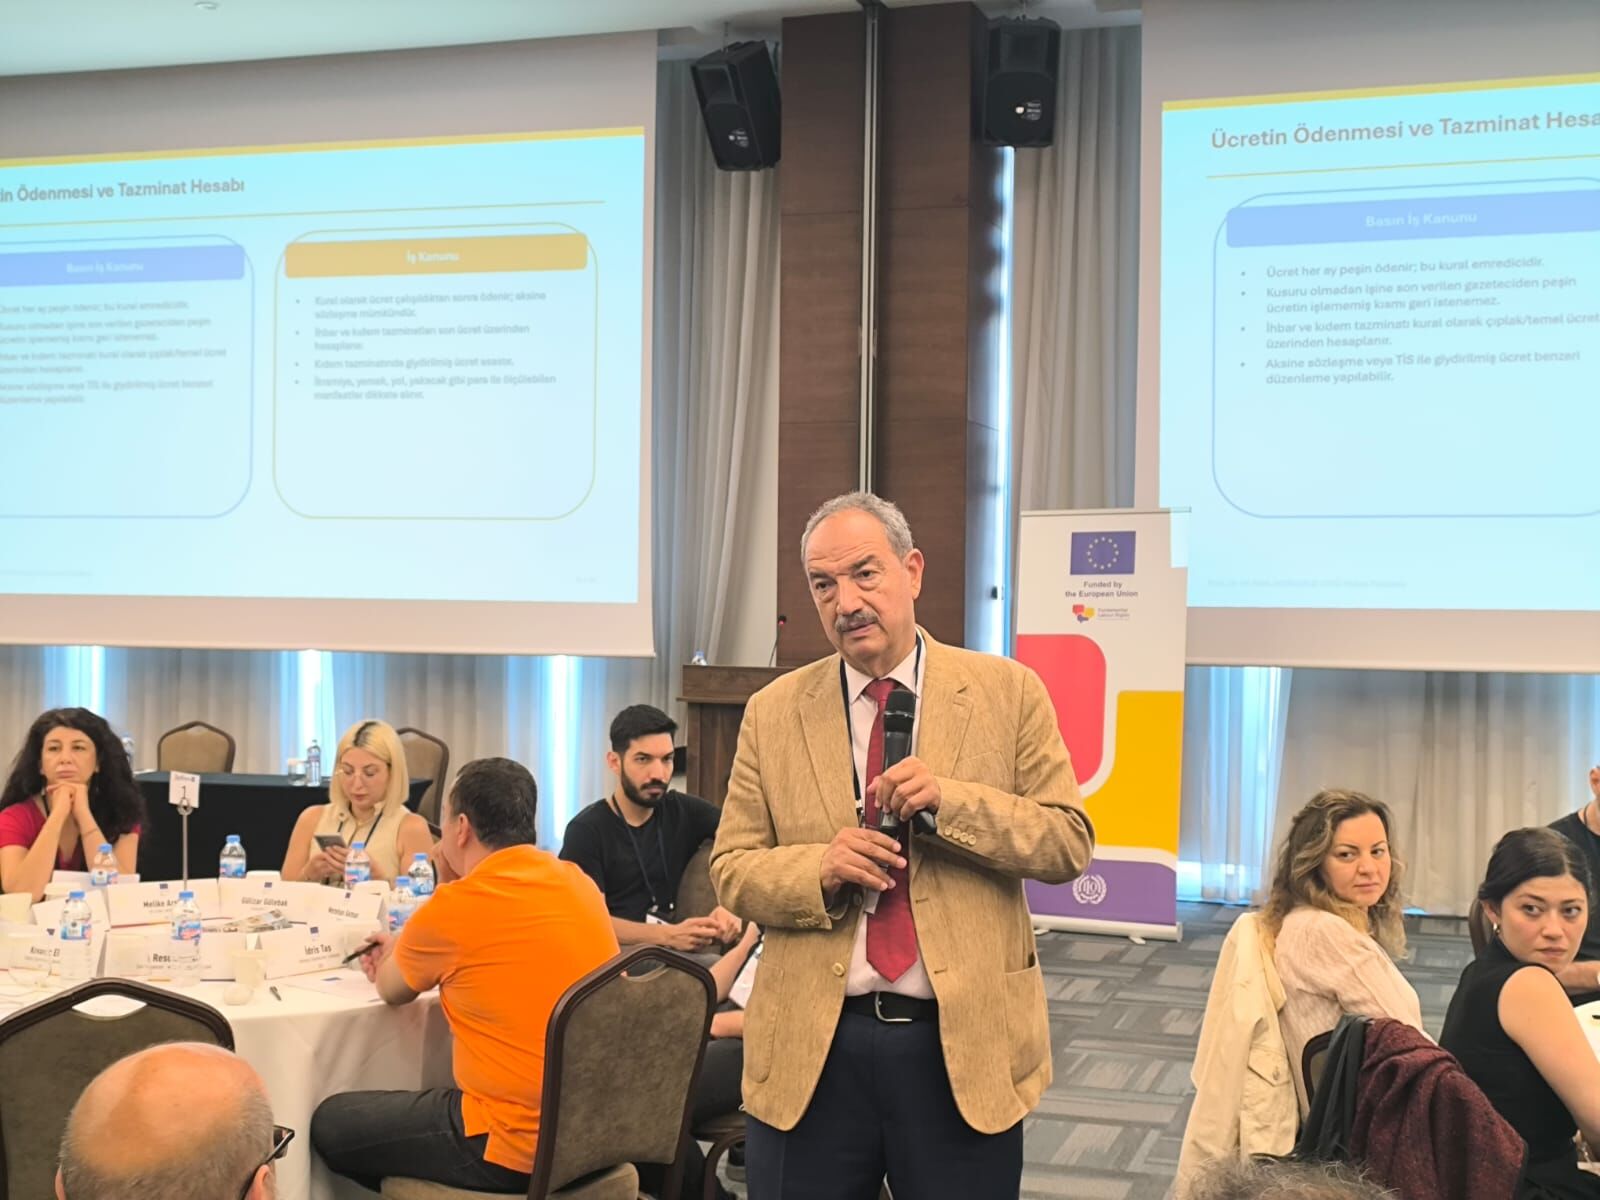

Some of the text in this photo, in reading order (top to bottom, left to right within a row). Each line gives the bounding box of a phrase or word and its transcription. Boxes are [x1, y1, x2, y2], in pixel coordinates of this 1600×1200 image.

[1211, 111, 1600, 149] Ücretin Ödenmesi ve Tazminat Hesa
[17, 183, 94, 201] Ödenmesi
[96, 187, 115, 198] ve
[118, 180, 187, 197] Tazminat
[190, 177, 245, 194] Hesabı
[1266, 265, 1299, 277] Ücret
[1301, 267, 1321, 276] her
[1419, 261, 1436, 271] bu
[1438, 260, 1469, 270] kural
[1266, 287, 1308, 297] Kusuru
[1298, 324, 1312, 332] ve
[1412, 318, 1442, 328] kural
[1083, 580, 1123, 589] Funded by
[1079, 590, 1114, 598] European
